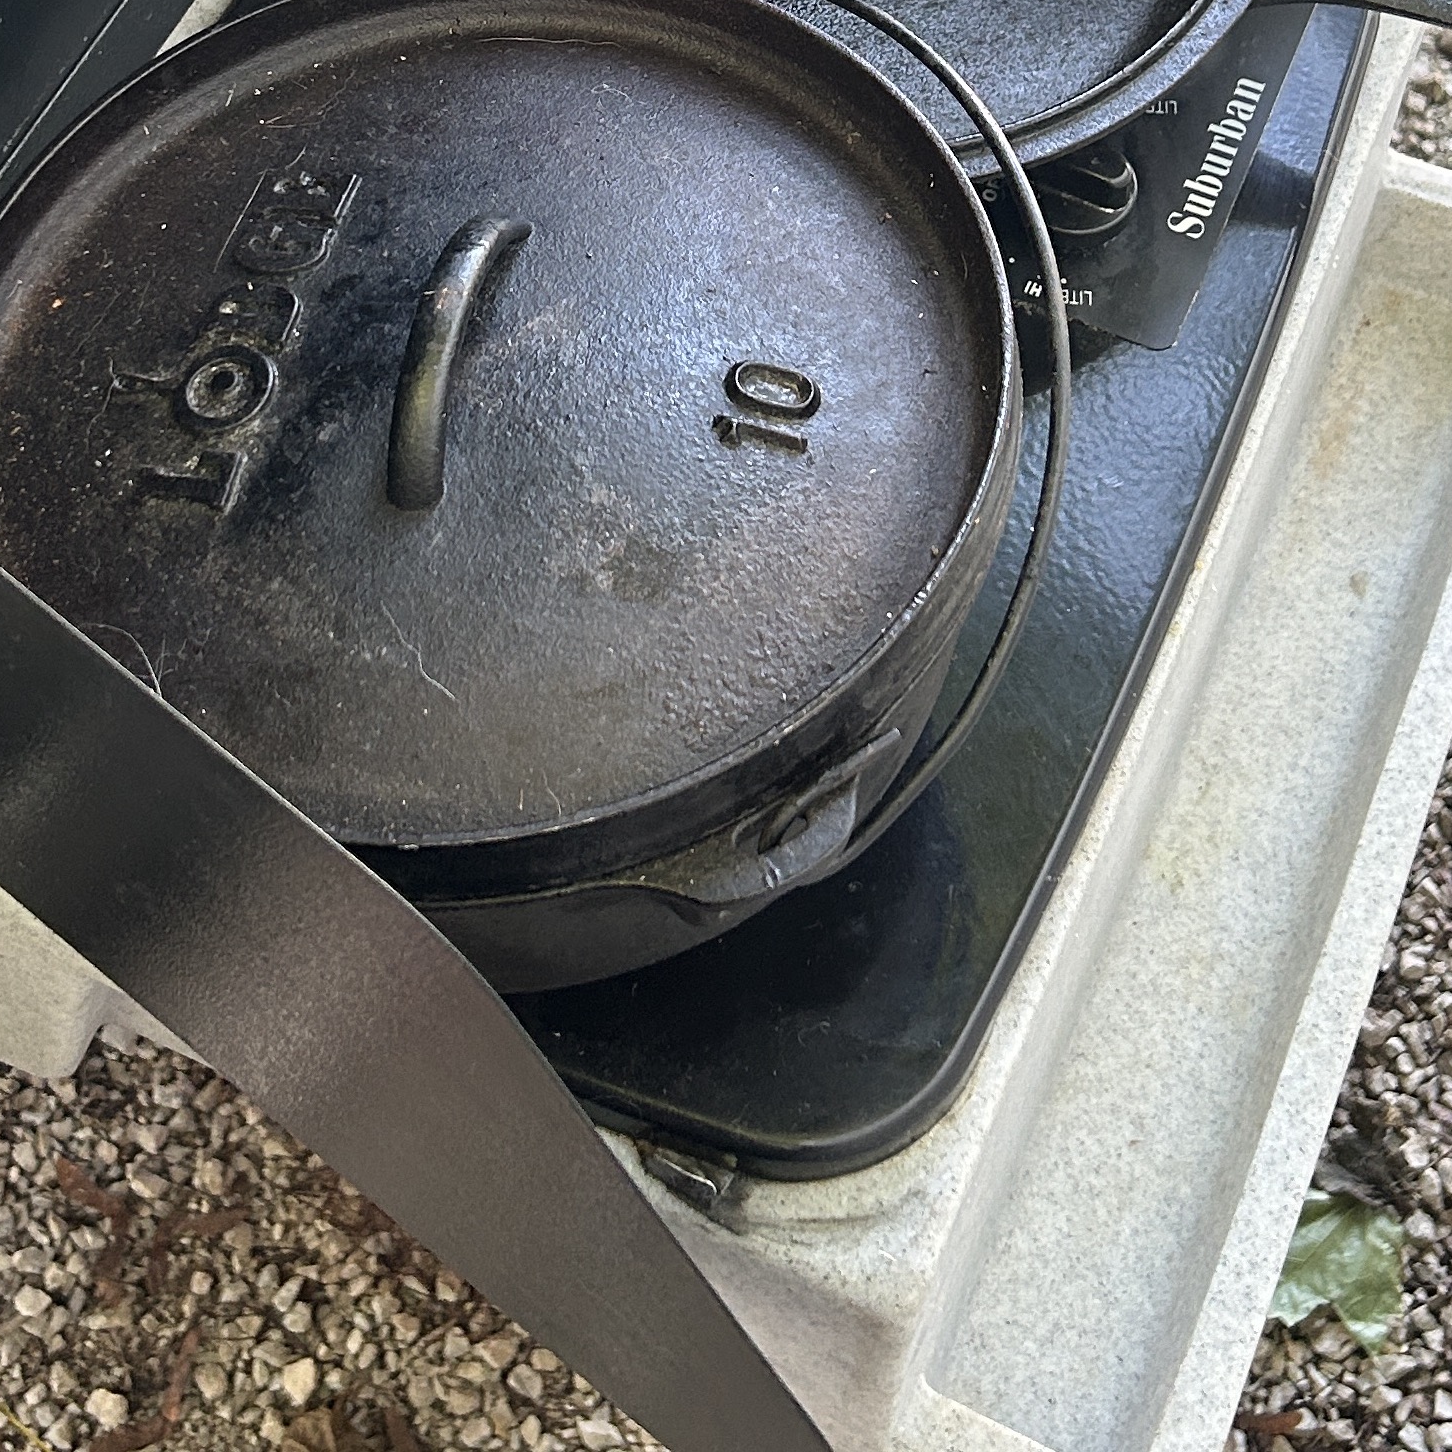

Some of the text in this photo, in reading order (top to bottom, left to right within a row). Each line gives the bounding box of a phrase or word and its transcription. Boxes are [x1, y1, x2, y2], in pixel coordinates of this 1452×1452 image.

[1166, 77, 1267, 240] Suburban
[1023, 280, 1043, 298] HI
[712, 359, 822, 454] 10
